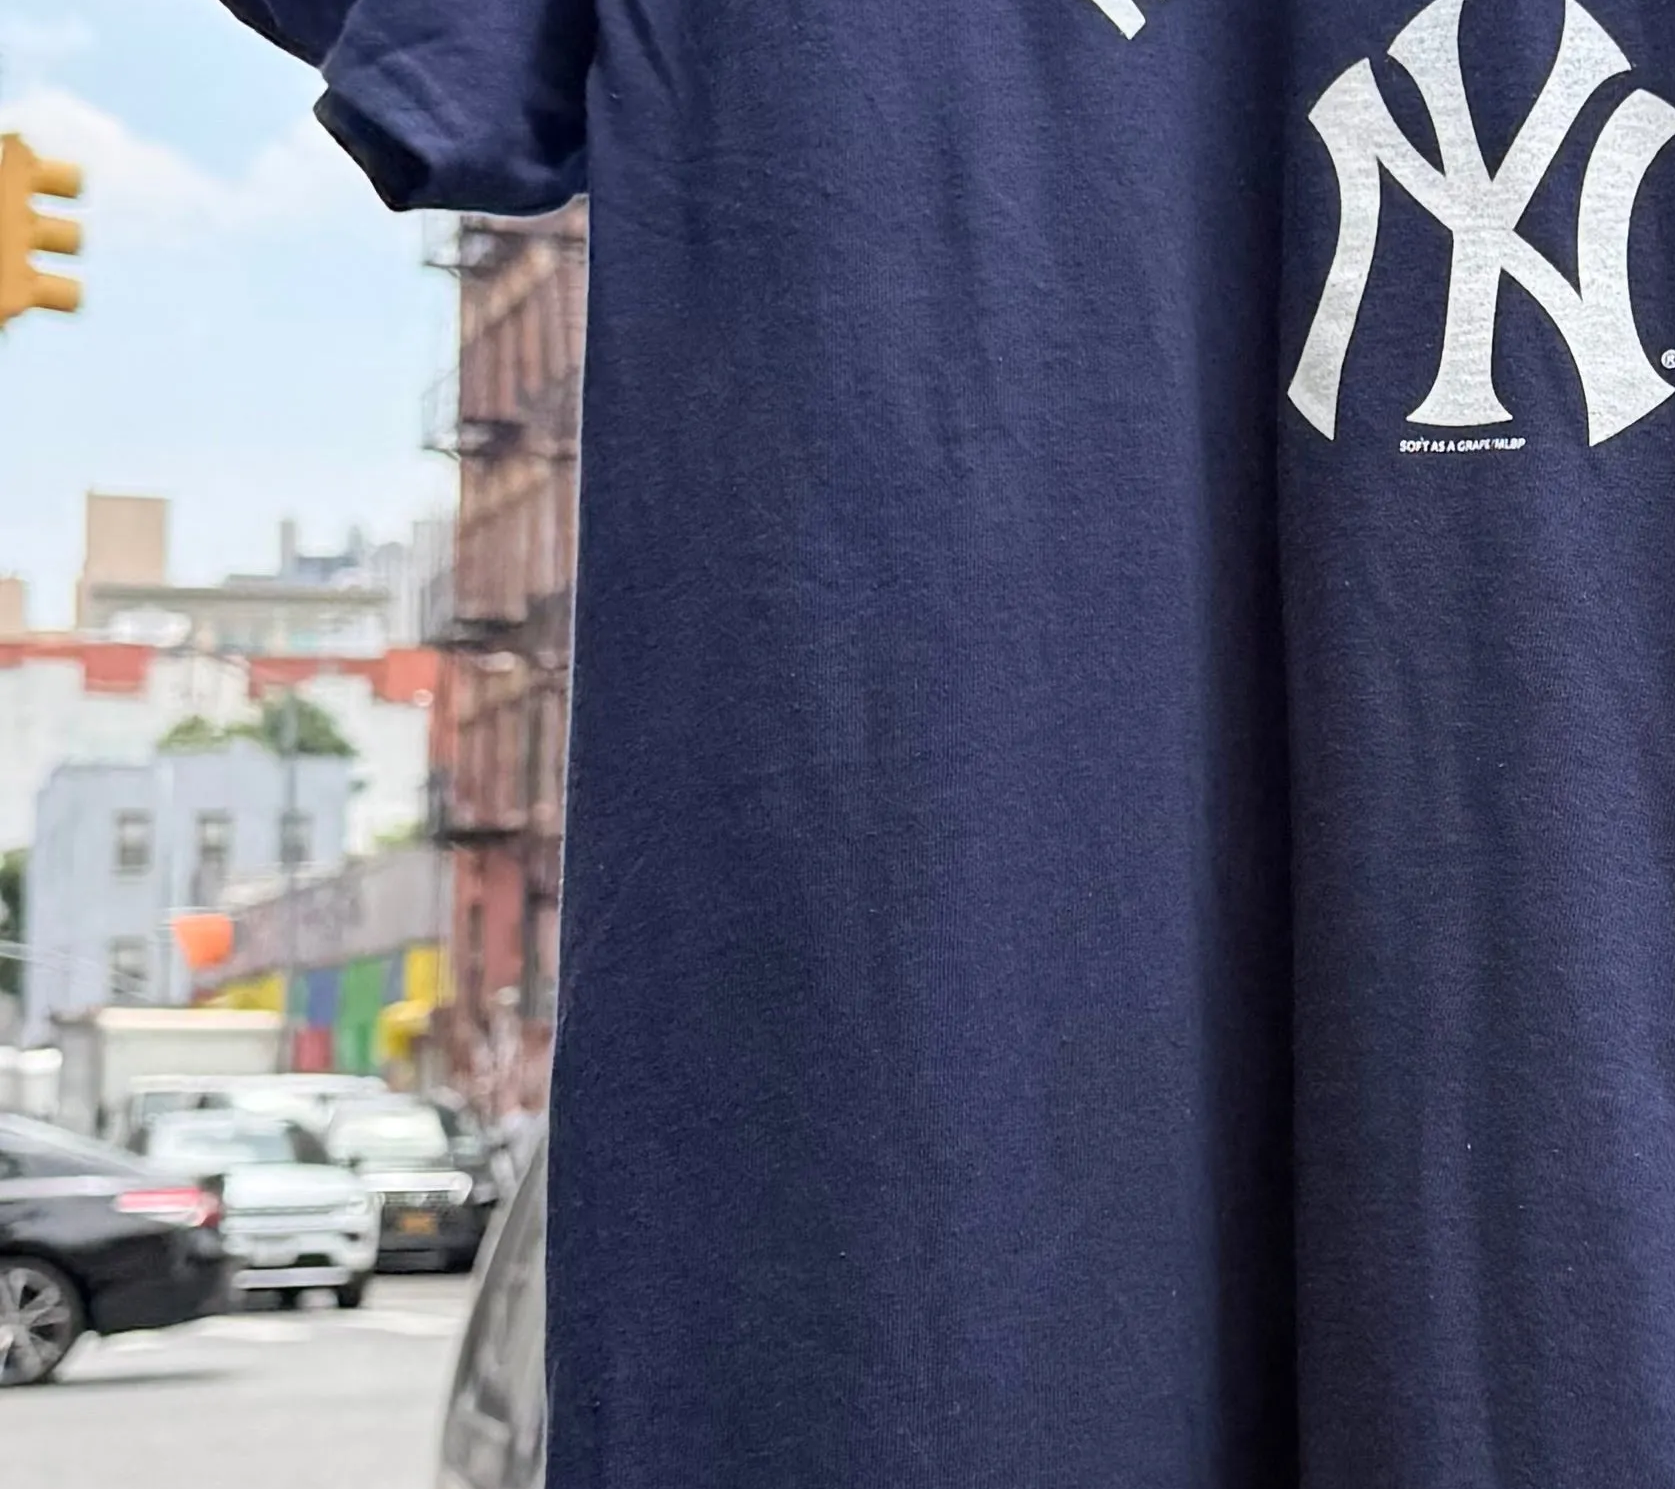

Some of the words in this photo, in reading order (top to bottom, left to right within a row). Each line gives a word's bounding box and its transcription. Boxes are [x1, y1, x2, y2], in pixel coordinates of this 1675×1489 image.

[1400, 438, 1430, 453] SOFT
[1430, 439, 1446, 453] AS
[1446, 439, 1456, 453] A
